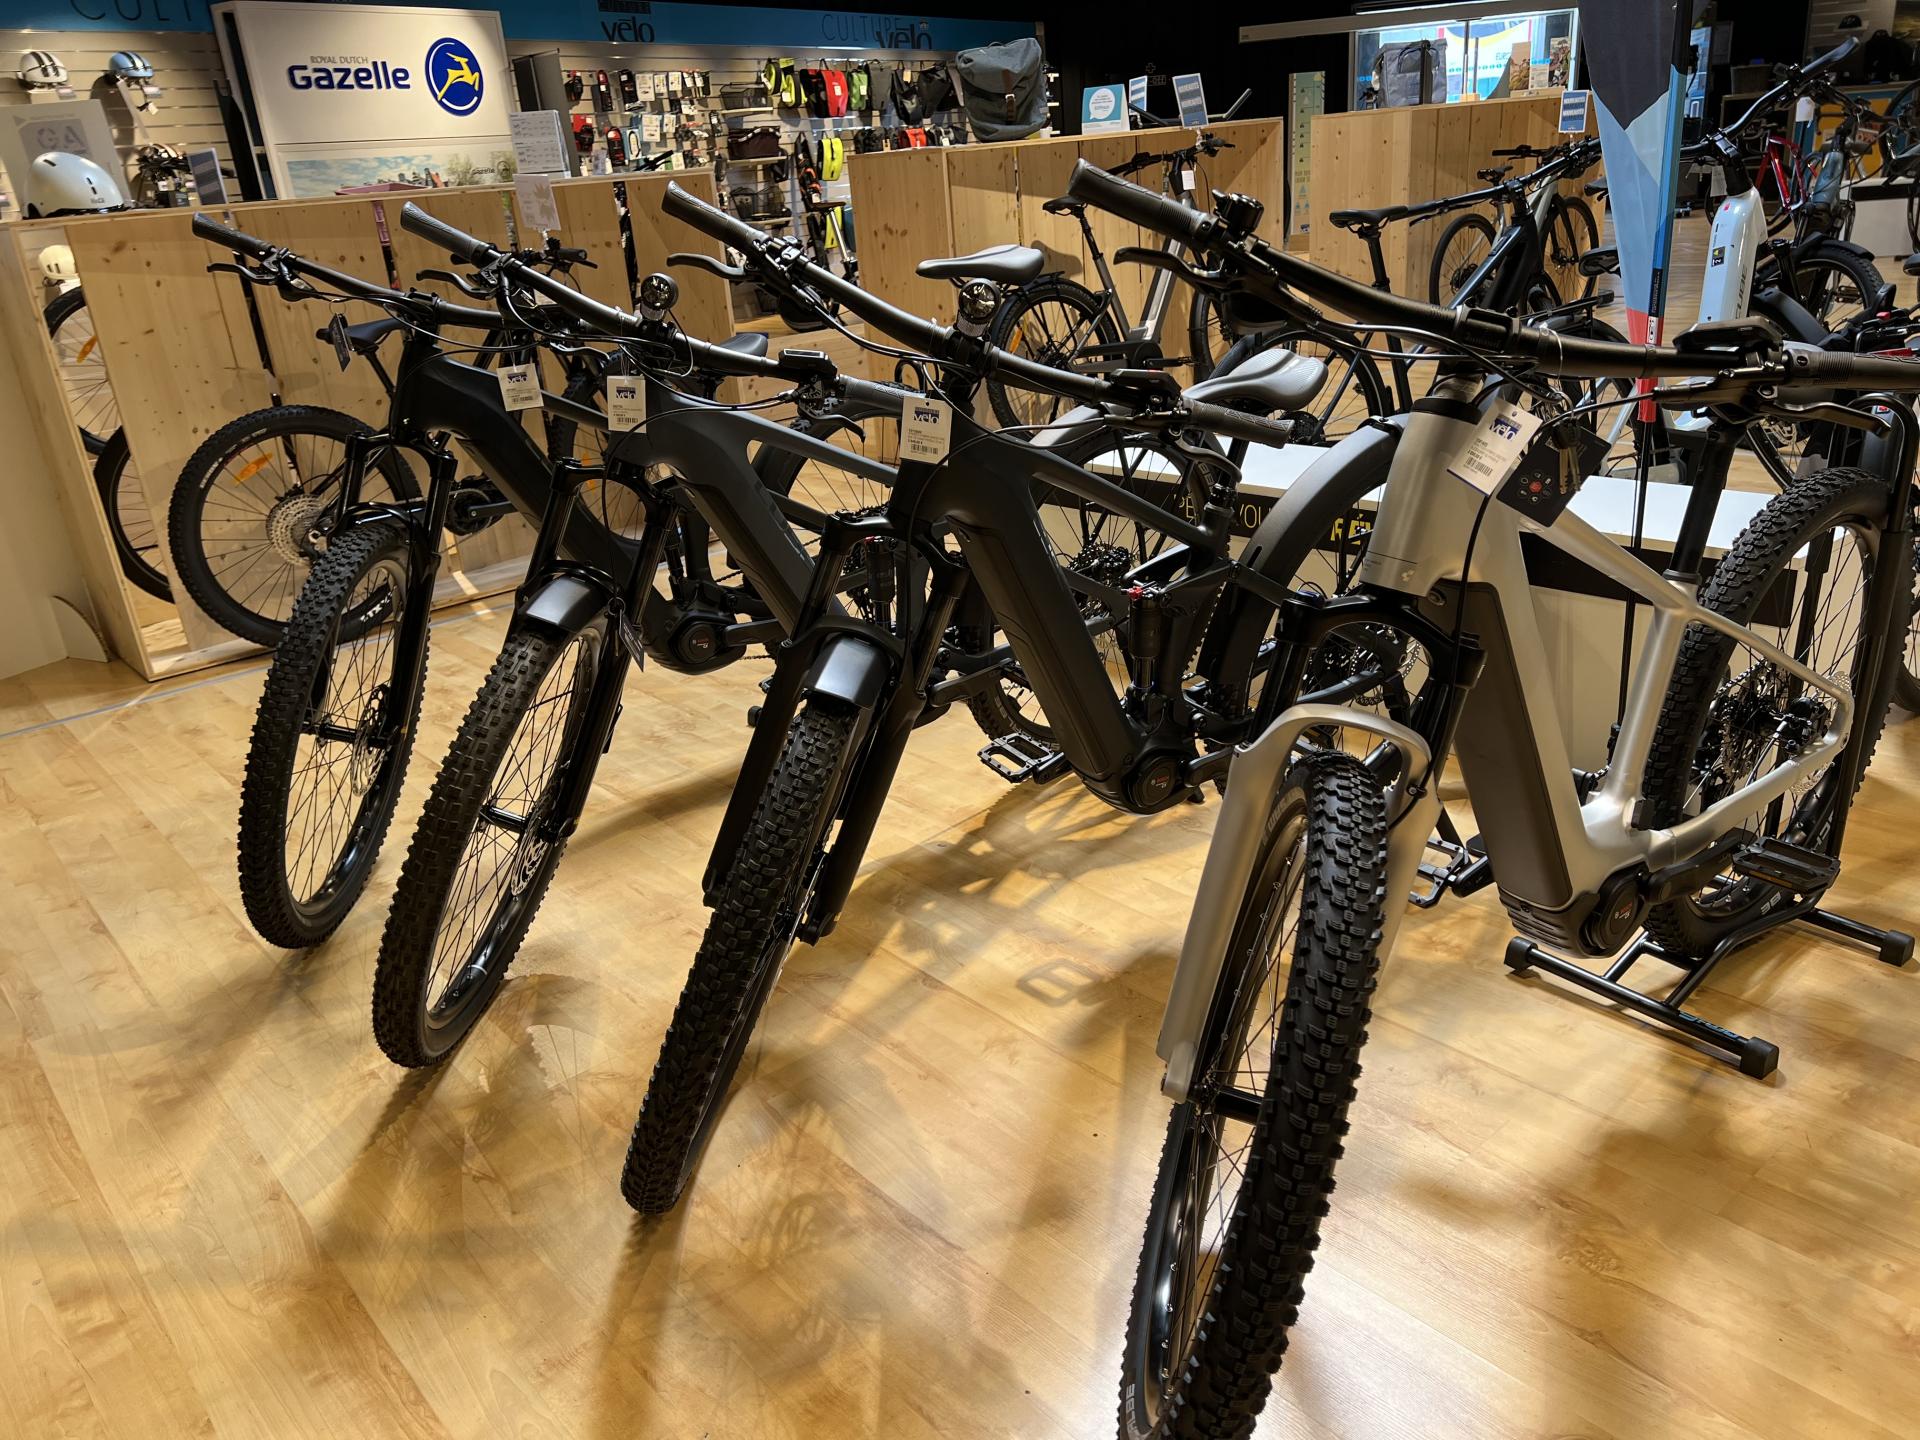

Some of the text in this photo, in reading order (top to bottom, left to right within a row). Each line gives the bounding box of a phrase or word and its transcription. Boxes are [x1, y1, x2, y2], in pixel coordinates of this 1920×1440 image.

[311, 56, 368, 65] ROYAL DUTCH
[288, 61, 411, 90] Gazelle
